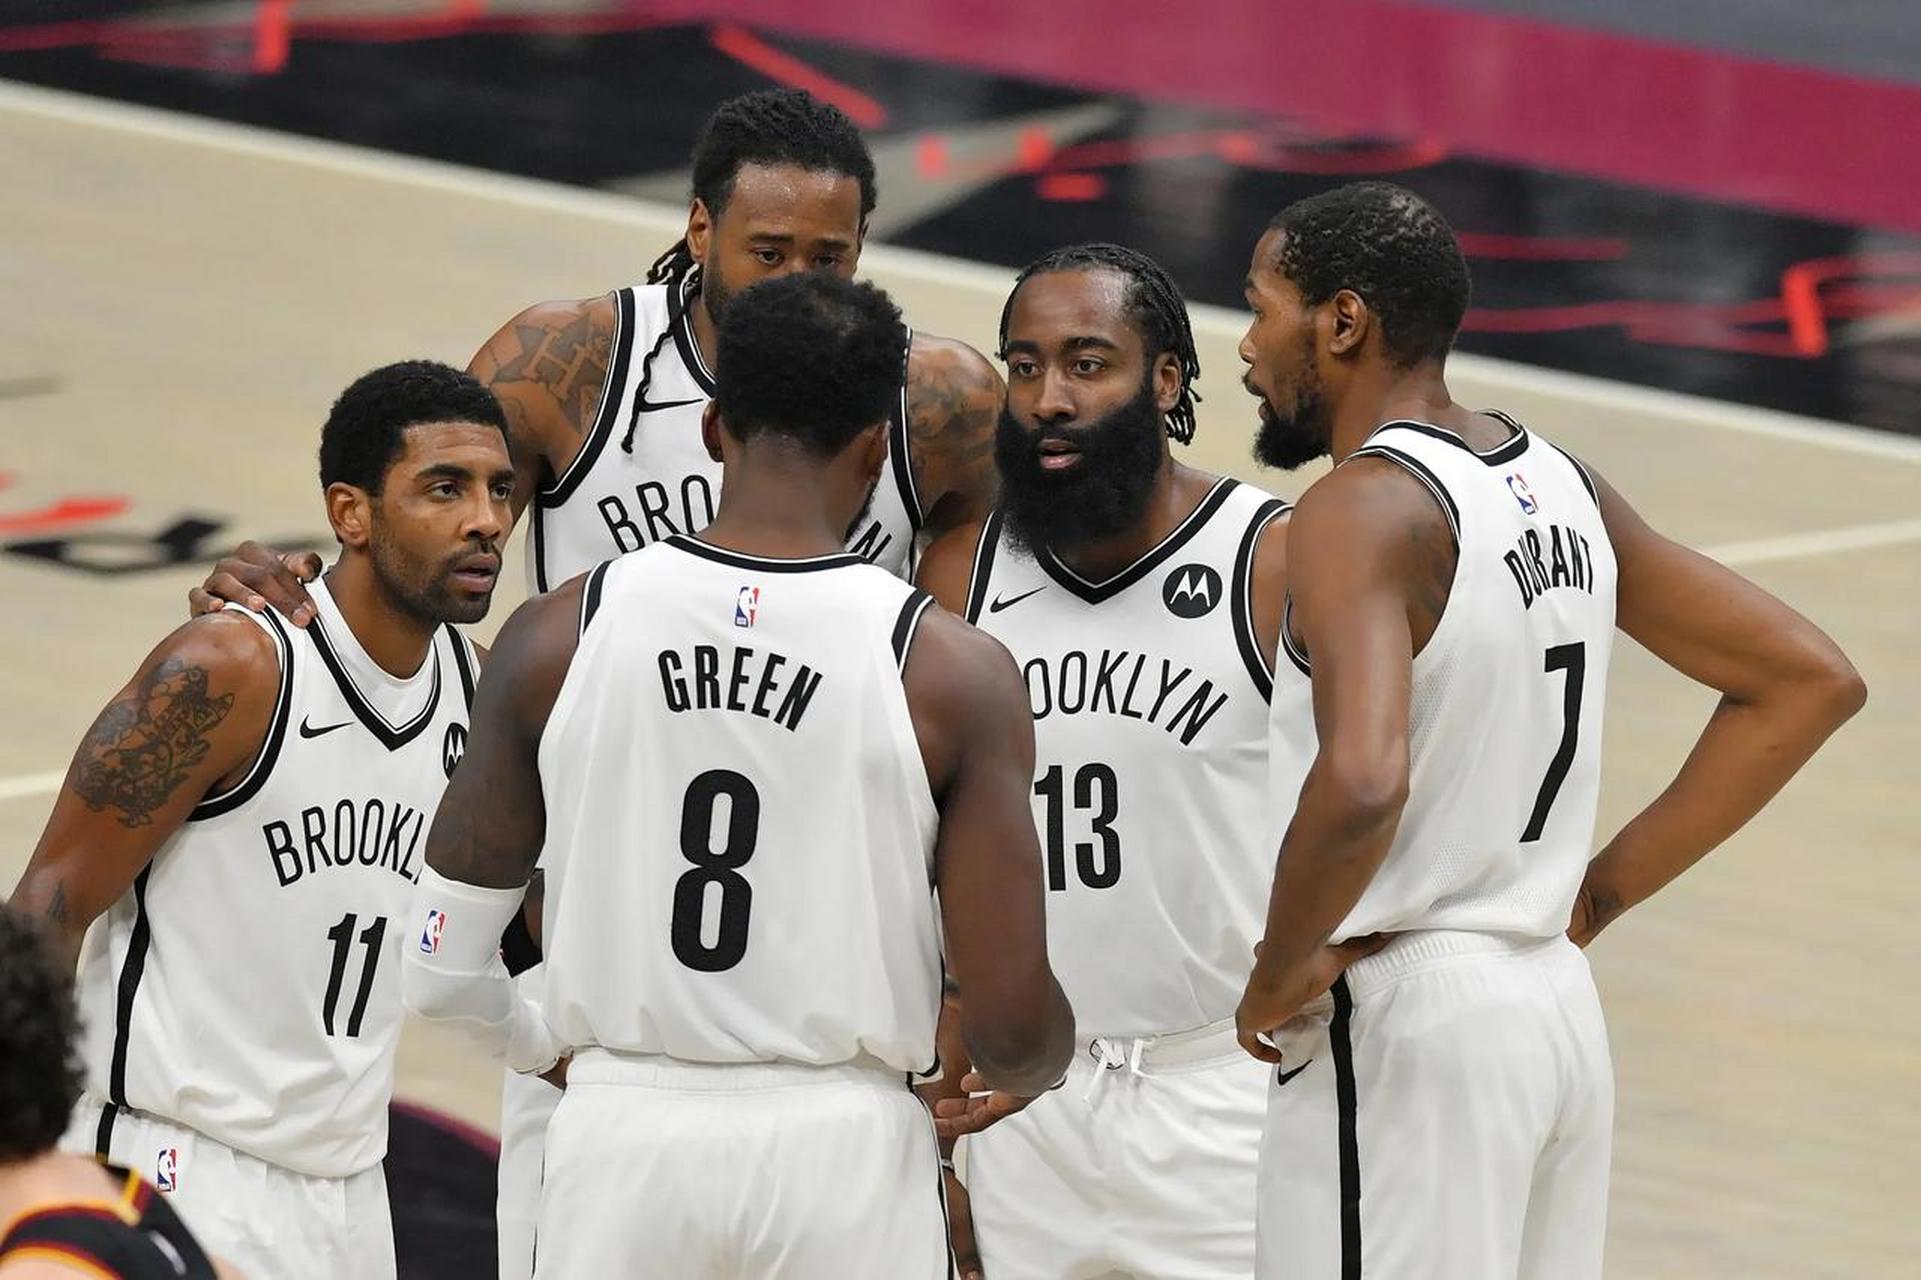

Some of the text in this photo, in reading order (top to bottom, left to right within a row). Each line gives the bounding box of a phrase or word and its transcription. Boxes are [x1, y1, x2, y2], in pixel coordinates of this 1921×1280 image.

[1503, 525, 1593, 611] DURANT
[657, 644, 823, 733] GREEN
[1023, 649, 1229, 747] OOKLYN
[1518, 641, 1586, 843] 7
[262, 798, 425, 887] BROOKL
[671, 769, 760, 972] 8
[1033, 762, 1122, 892] 13
[322, 912, 388, 1038] 11
